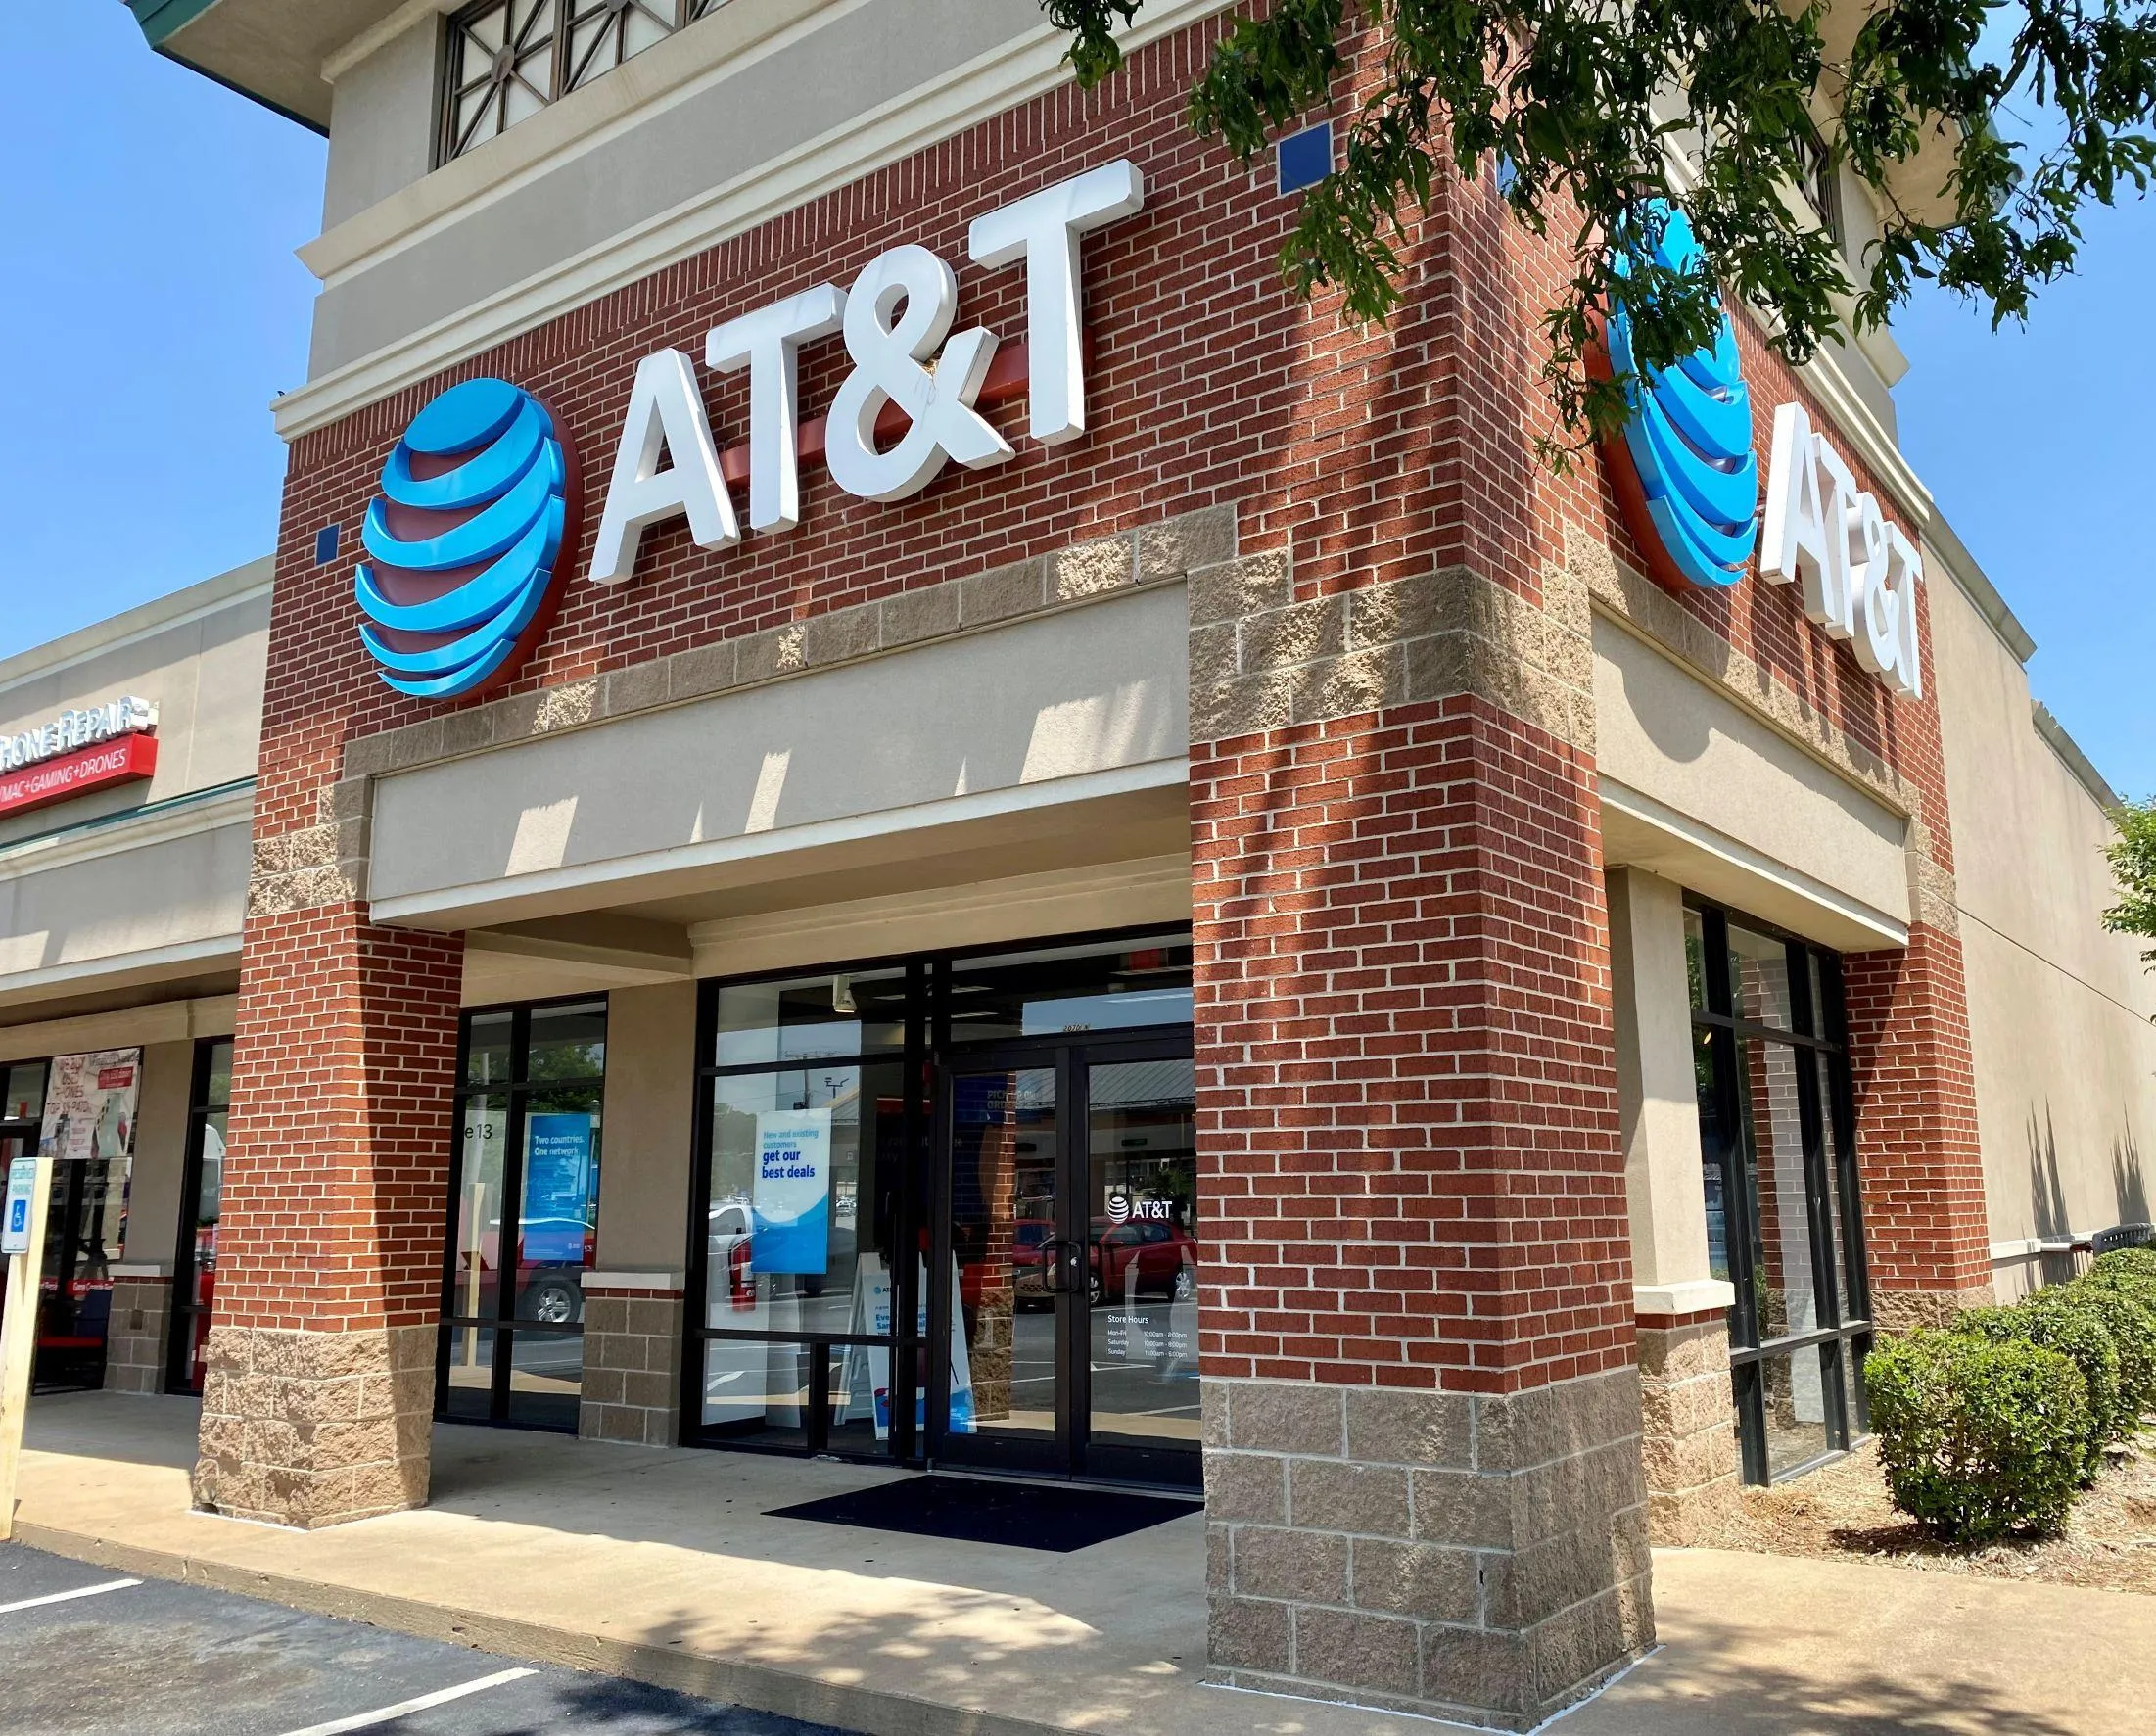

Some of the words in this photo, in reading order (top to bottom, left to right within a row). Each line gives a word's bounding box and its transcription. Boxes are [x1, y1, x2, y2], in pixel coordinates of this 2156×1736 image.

[588, 158, 1145, 585] AT&T
[1760, 401, 1924, 700] AT&T
[57, 696, 139, 752] REPAIR
[477, 1123, 492, 1140] 13
[778, 1129, 791, 1139] and
[792, 1128, 819, 1139] existing
[534, 1135, 549, 1145] Two
[763, 1140, 797, 1149] customers
[534, 1147, 548, 1156] One
[763, 1150, 780, 1166] get
[782, 1150, 801, 1161] our
[762, 1165, 784, 1179] best
[787, 1164, 816, 1178] deals
[1132, 1200, 1173, 1219] AT&T
[1107, 1314, 1127, 1323] Store
[1128, 1315, 1149, 1324] Hours
